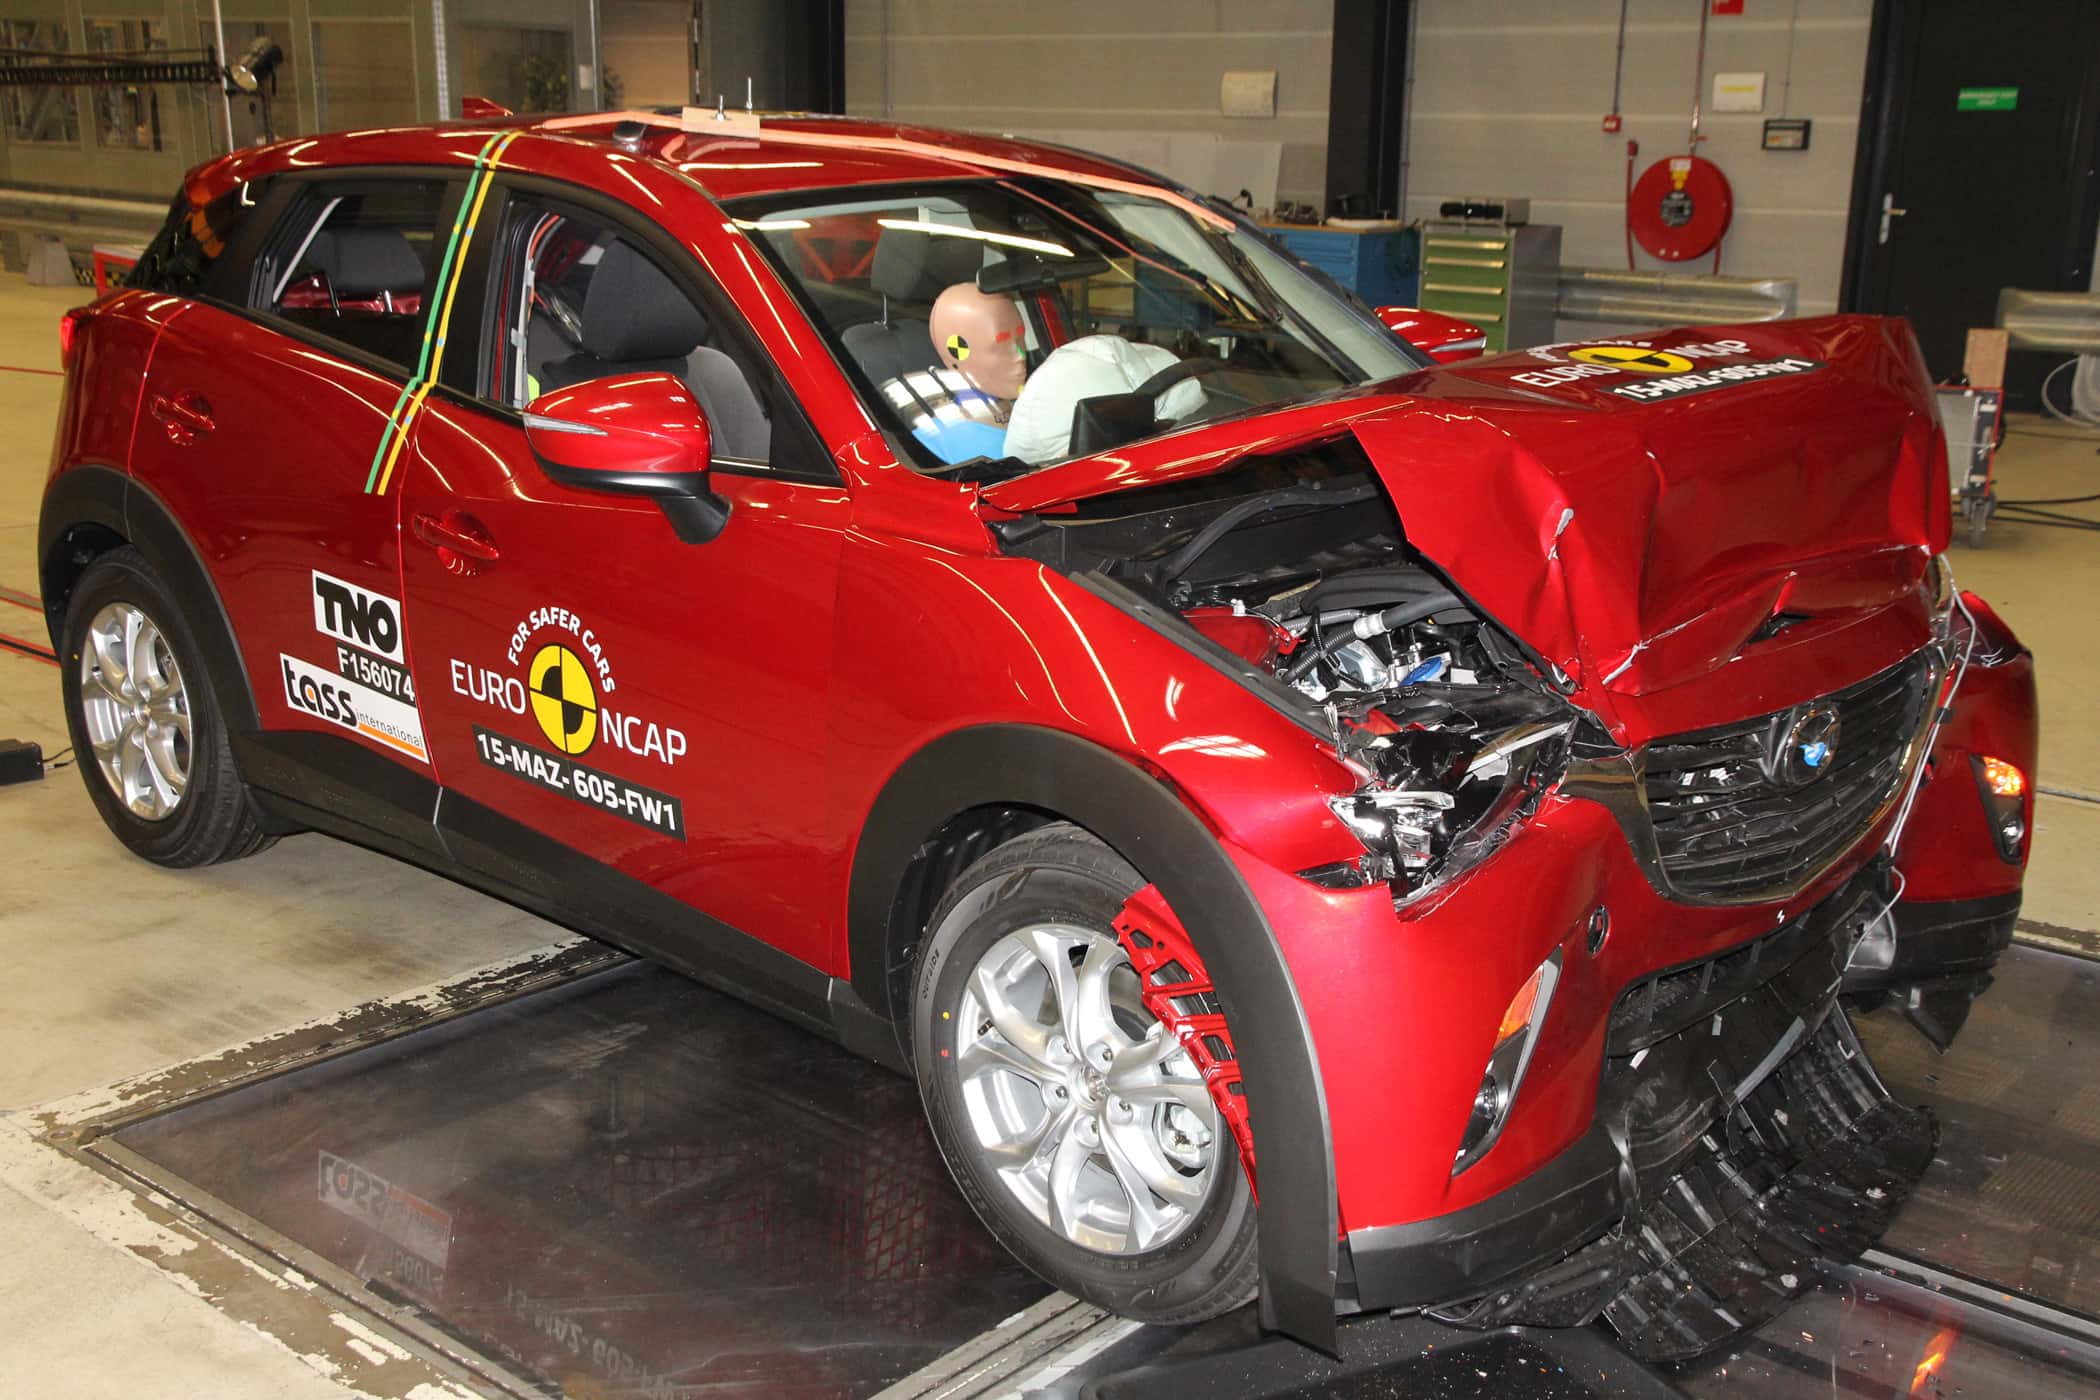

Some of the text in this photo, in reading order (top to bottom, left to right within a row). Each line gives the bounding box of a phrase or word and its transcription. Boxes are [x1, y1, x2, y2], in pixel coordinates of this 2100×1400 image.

[1509, 362, 1621, 388] EURO
[315, 576, 398, 654] TNO
[508, 606, 616, 693] FOR SAFER CARS
[283, 658, 358, 727] tass
[337, 647, 415, 702] F156074
[356, 708, 424, 748] international
[450, 658, 687, 766] EURO NCAP
